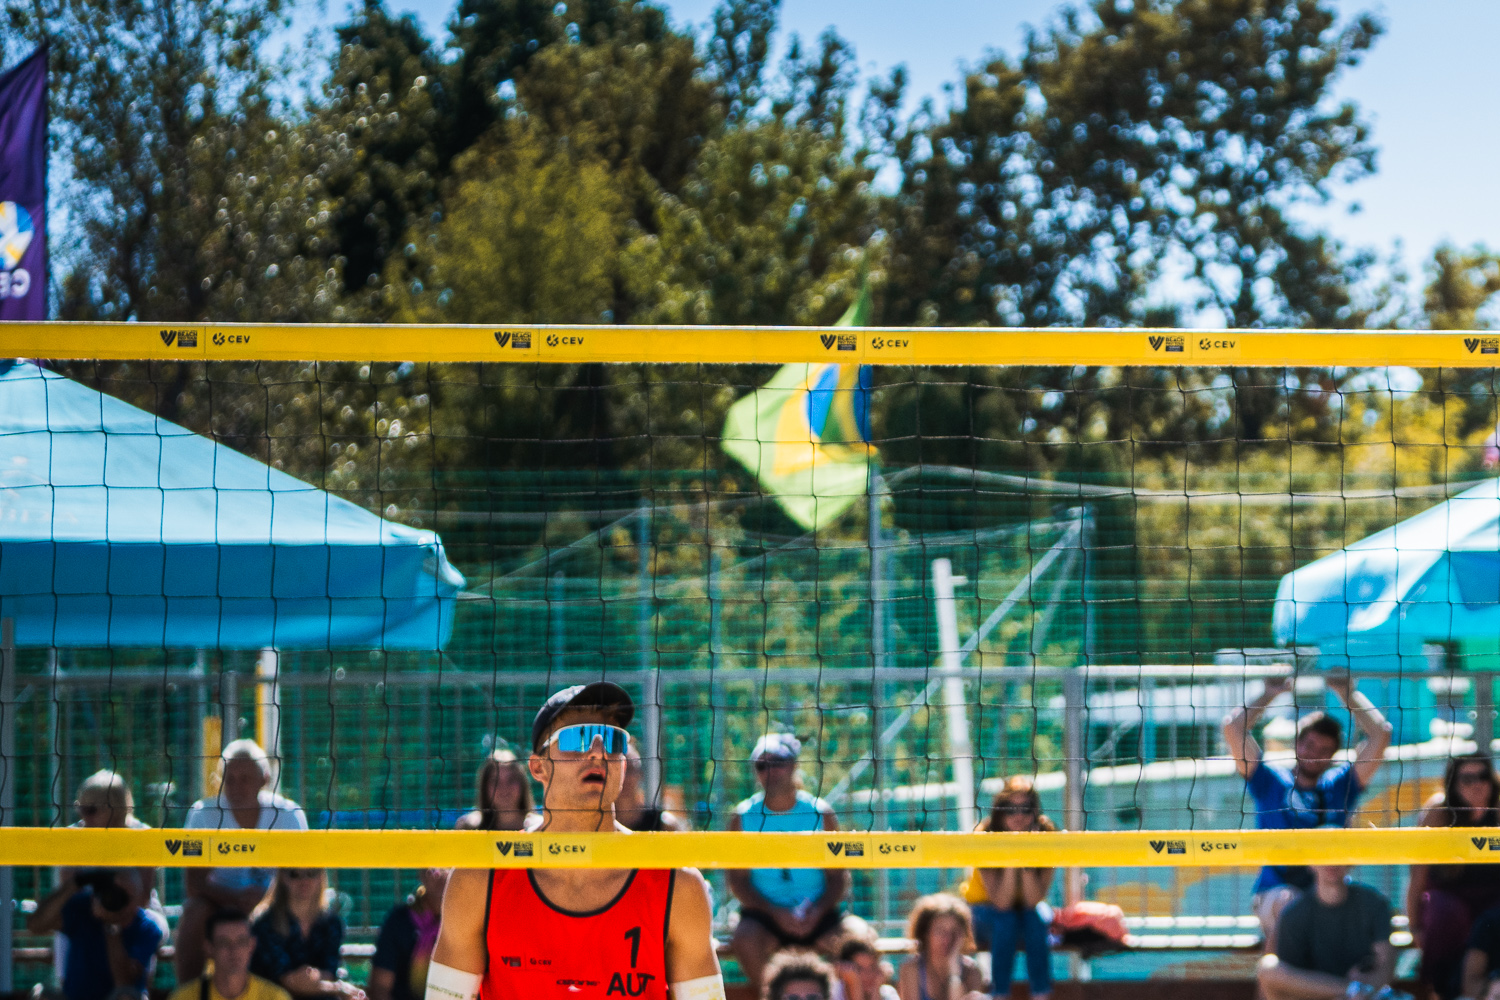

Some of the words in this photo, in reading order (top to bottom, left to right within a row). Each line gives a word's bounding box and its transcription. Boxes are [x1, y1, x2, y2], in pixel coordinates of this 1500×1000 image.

[228, 335, 250, 344] CEV
[562, 336, 584, 345] CEV
[1214, 340, 1236, 348] CEV
[233, 844, 256, 852] CEV
[624, 926, 642, 968] 1
[606, 972, 655, 997] AUT
